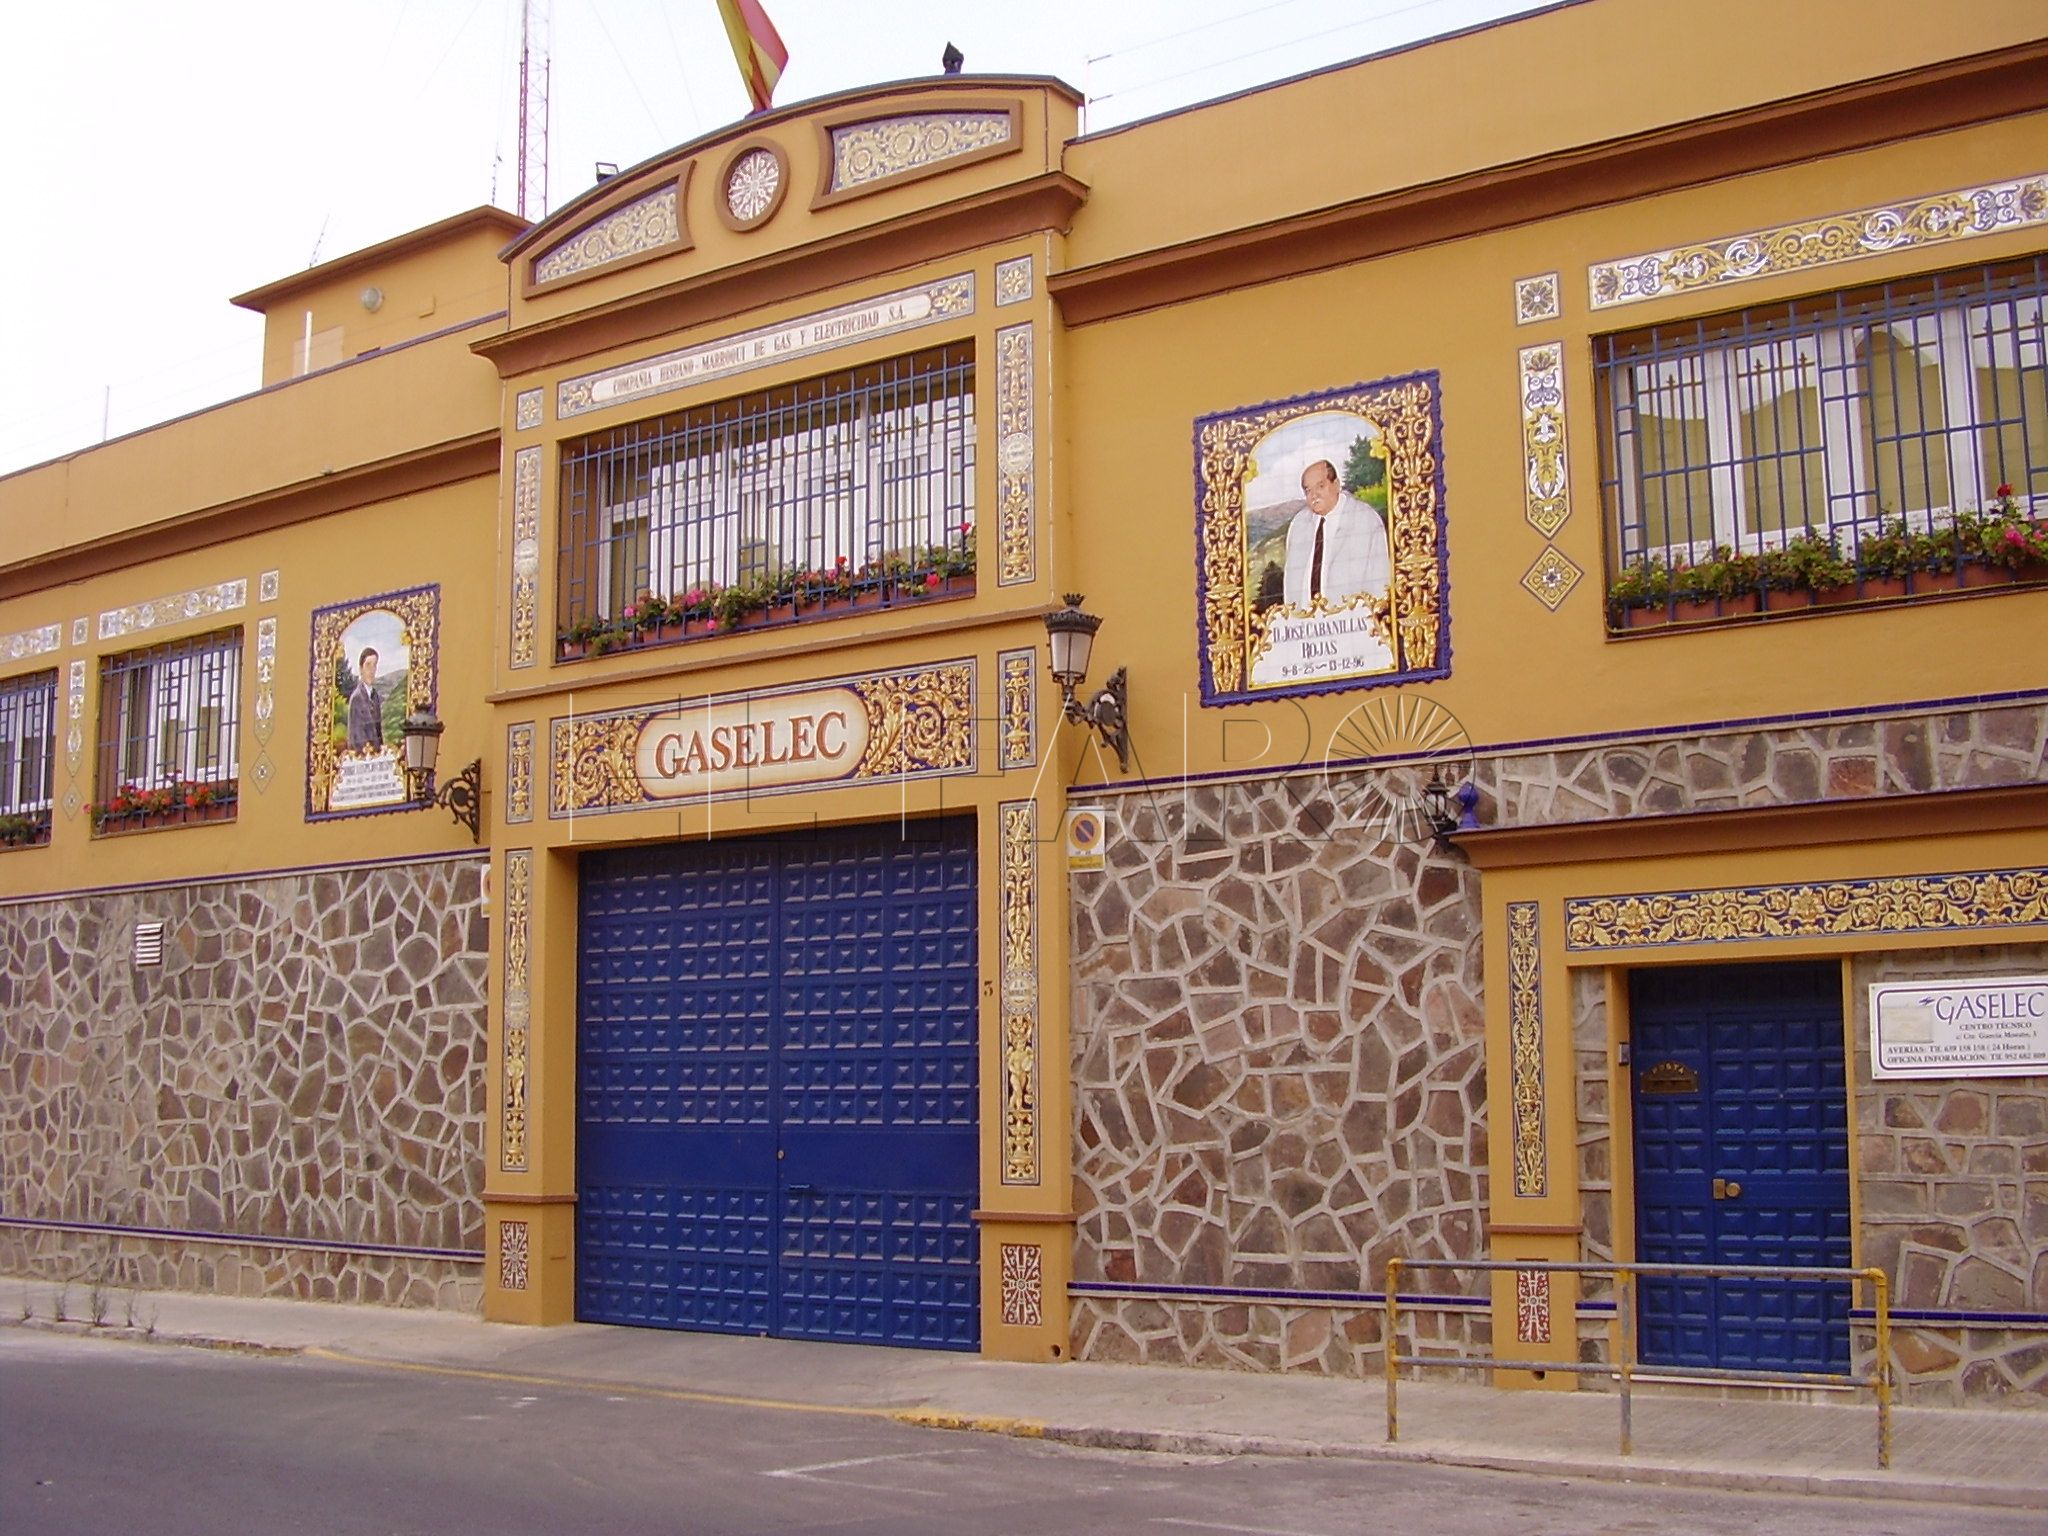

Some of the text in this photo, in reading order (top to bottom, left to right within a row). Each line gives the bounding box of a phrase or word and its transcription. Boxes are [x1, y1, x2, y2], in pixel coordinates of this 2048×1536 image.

[753, 340, 766, 357] DE
[773, 333, 792, 351] GAS
[800, 329, 806, 346] Y
[813, 309, 880, 343] ELECTRICIDAD
[1306, 616, 1369, 638] CABANILLAS
[1301, 641, 1338, 659] ROJAS
[654, 709, 849, 780] GASELEC
[1935, 991, 2046, 1026] GASELEC
[1959, 1022, 1993, 1031] CENTRO
[1887, 1055, 1923, 1065] OFICINA
